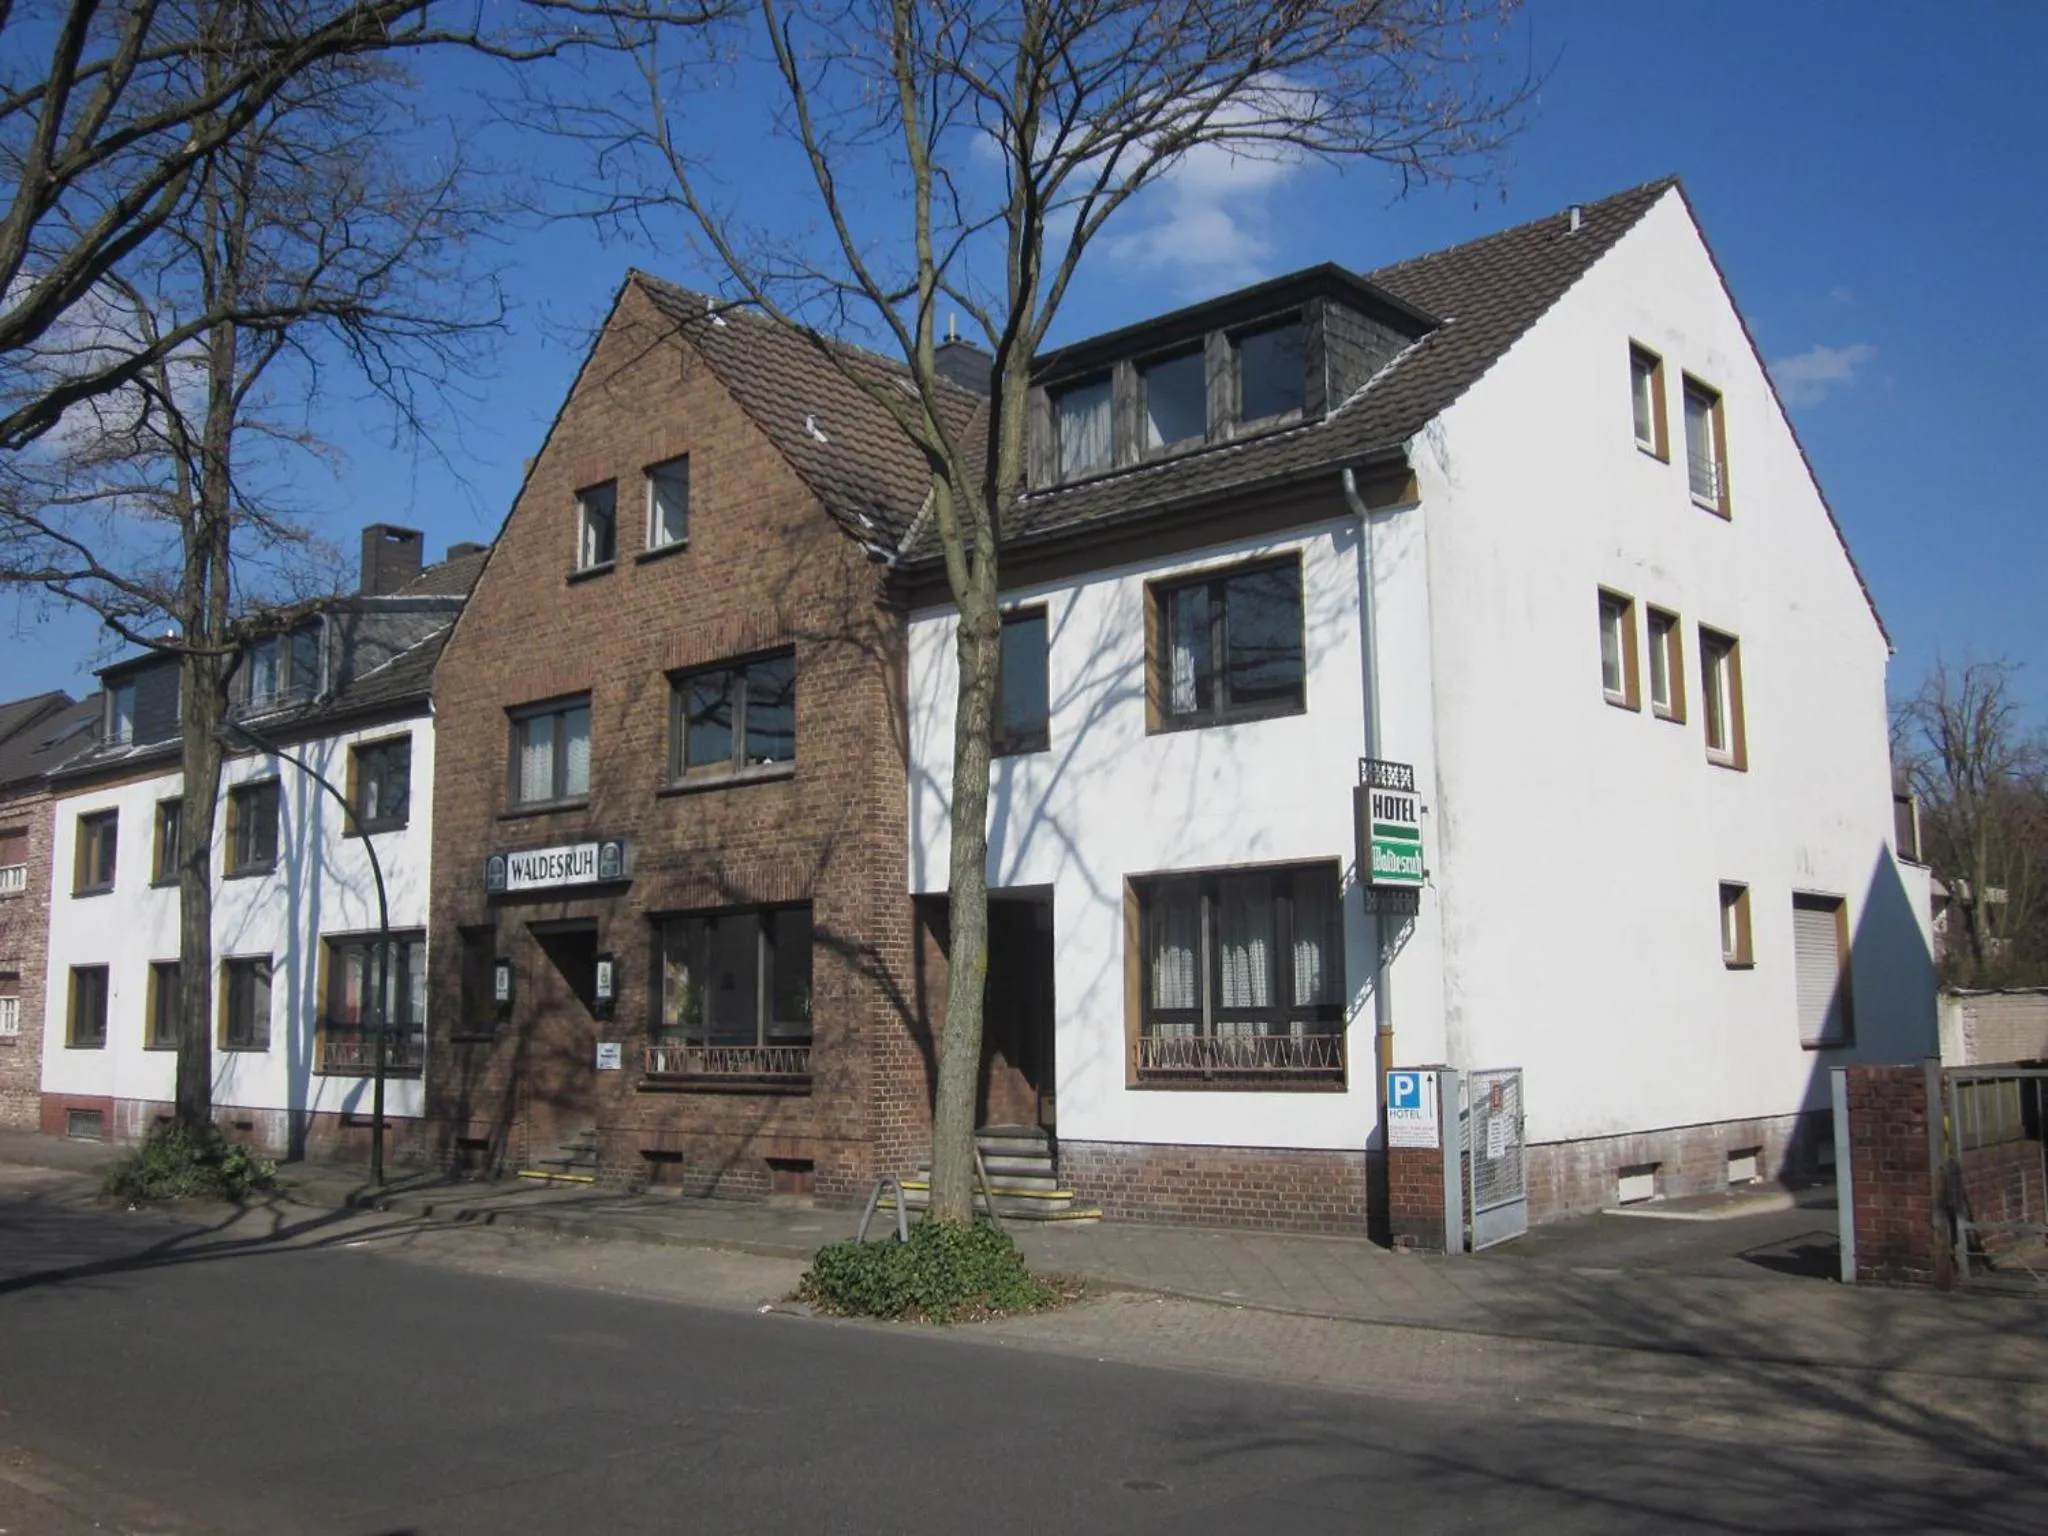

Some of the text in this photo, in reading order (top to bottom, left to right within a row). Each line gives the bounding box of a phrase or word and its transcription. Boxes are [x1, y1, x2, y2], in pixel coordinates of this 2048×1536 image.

[1373, 794, 1416, 822] HOTEL
[511, 850, 593, 881] WALDESRUH
[1394, 1075, 1414, 1107] P
[1389, 1109, 1421, 1120] HOTEL
